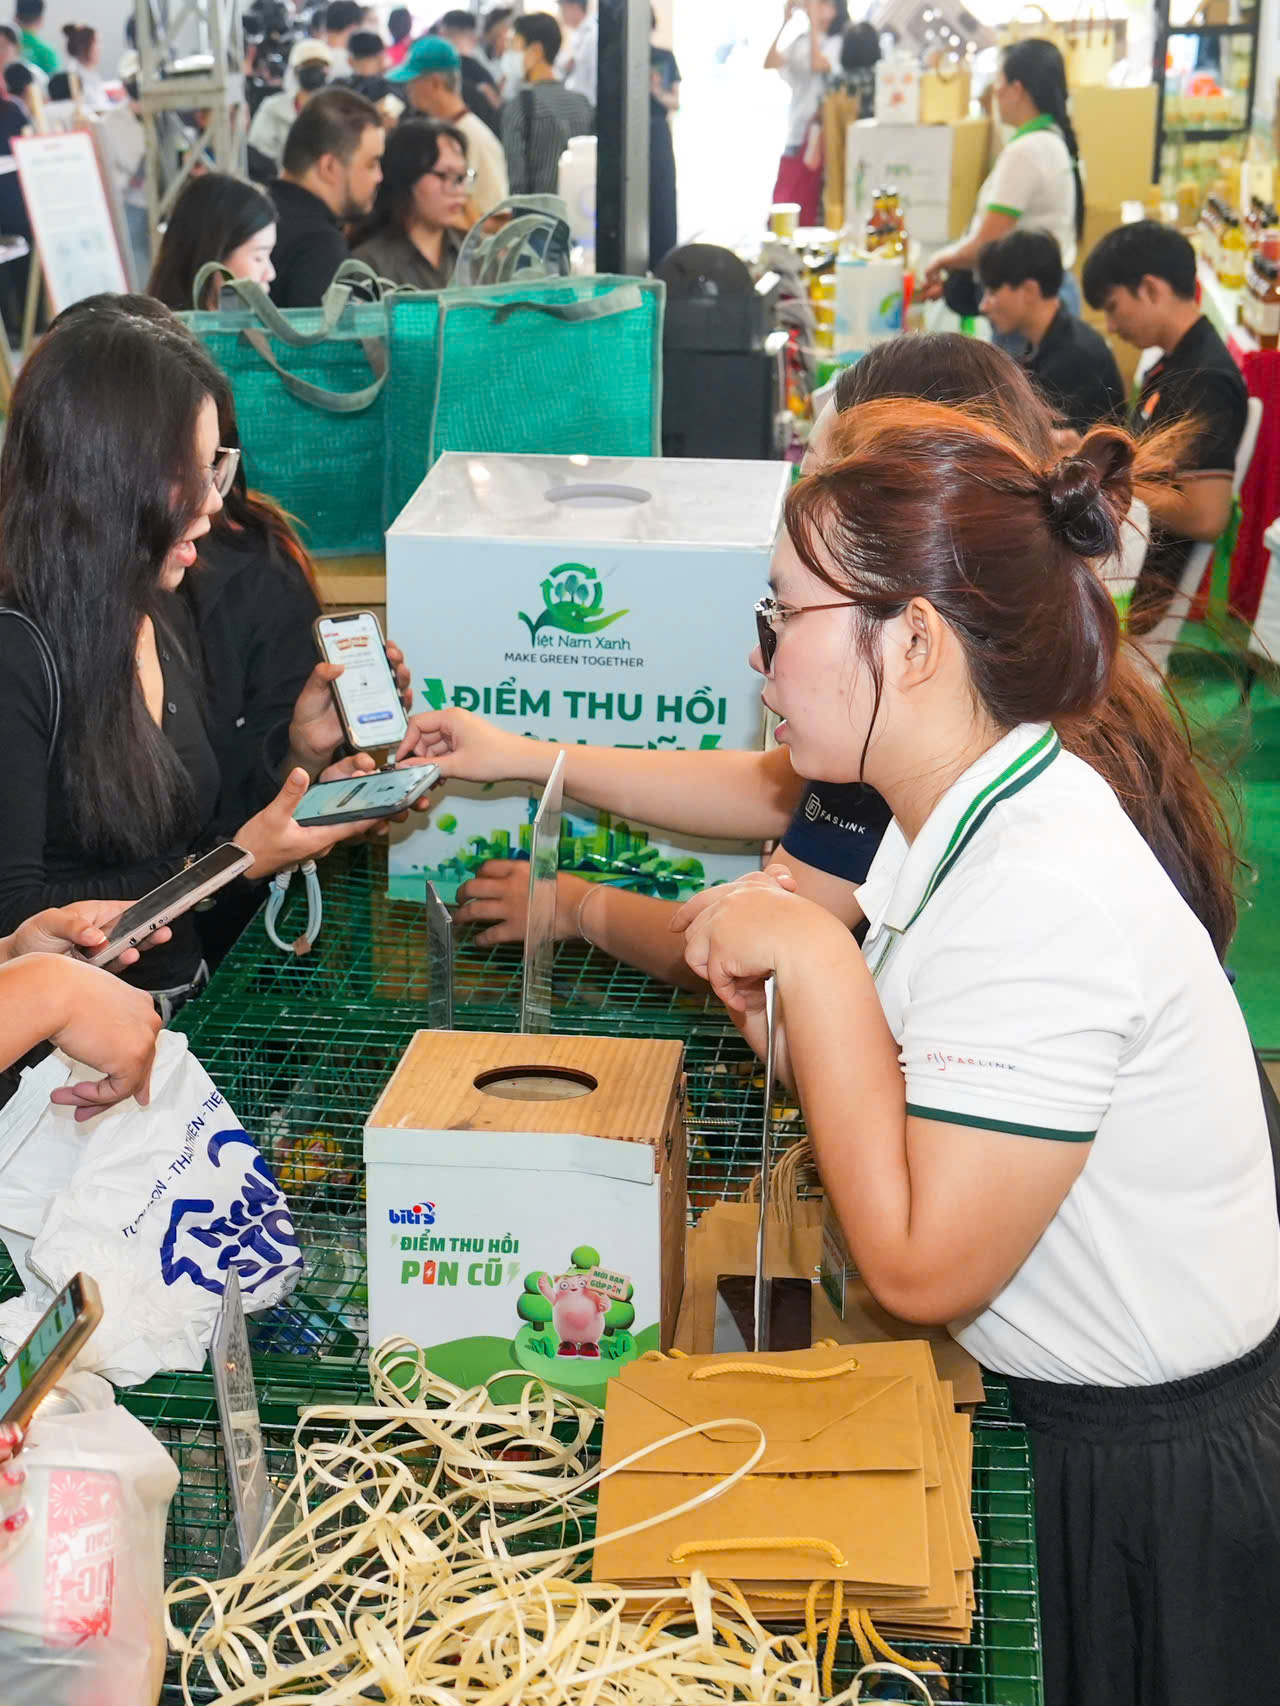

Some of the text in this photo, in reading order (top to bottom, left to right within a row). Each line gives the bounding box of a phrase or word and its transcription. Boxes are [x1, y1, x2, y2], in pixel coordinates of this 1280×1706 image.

[558, 635, 592, 649] Nam
[595, 636, 631, 651] Xanh
[504, 652, 644, 668] MAKE GREEN TOGETHER
[451, 676, 726, 725] ĐIỂM THU HỒI
[820, 810, 866, 834] FASLINK
[202, 1091, 224, 1112] TIỆ
[400, 1228, 519, 1254] ĐIỂM THU HỒI
[467, 1257, 503, 1286] CŨ
